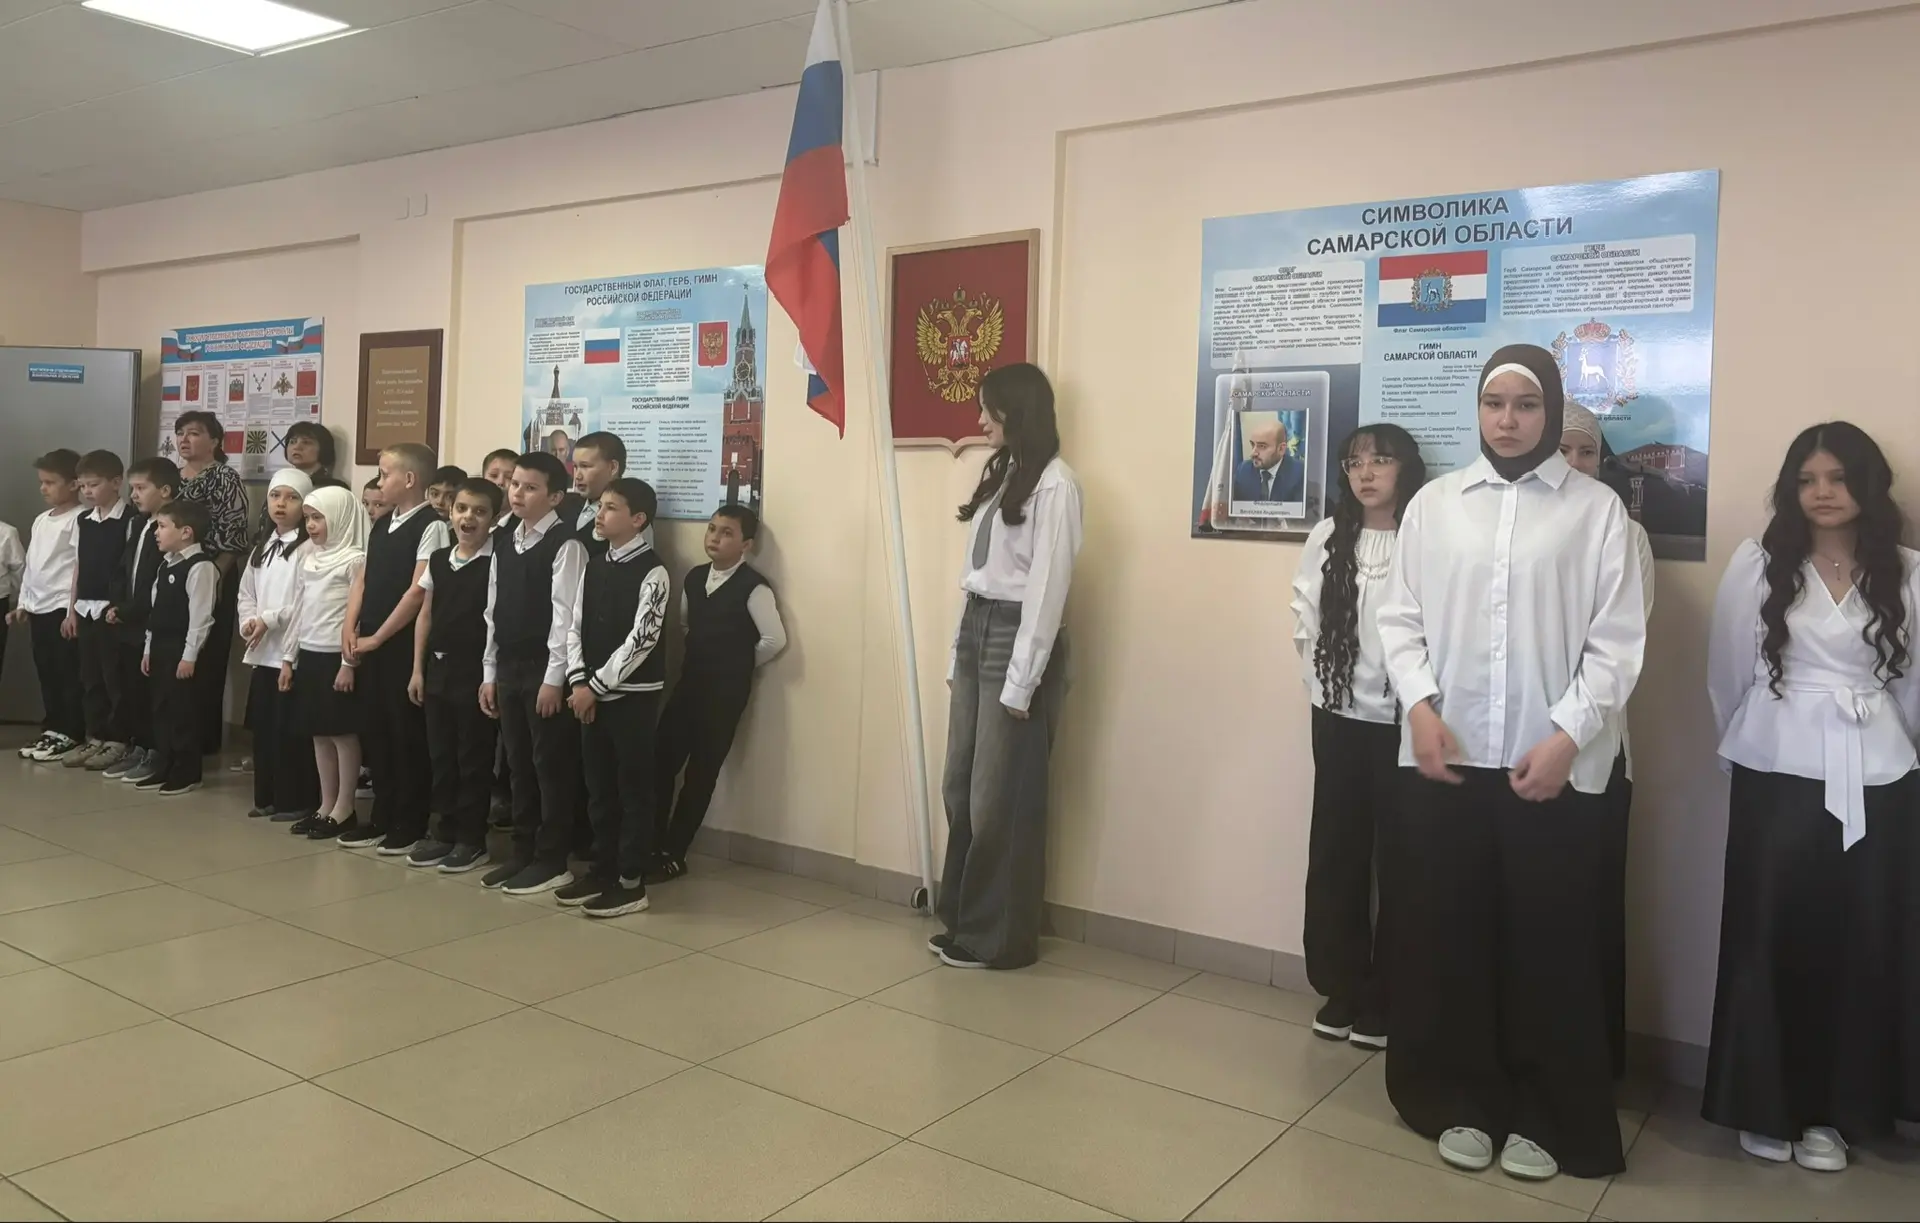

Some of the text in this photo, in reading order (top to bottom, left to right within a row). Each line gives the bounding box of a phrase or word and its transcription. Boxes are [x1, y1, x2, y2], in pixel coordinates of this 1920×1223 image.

[1361, 196, 1509, 226] СИМВОЛИКА
[1306, 216, 1573, 256] САМАРСКОЙ ОБЛАСТИ
[1550, 252, 1600, 262] САМАРСКОЙ
[1503, 266, 1517, 274] Герб
[564, 274, 718, 295] ГОСУДАРСТВЕННЫЙ ФЛАГ, ГЕРБ, ГИМН
[586, 288, 692, 306] РОССИЙСКОЙ ФЕДЕРАЦИИ
[1408, 326, 1440, 334] Самарской
[1384, 350, 1478, 361] САМАРСКОЙ ОБЛАСТИ
